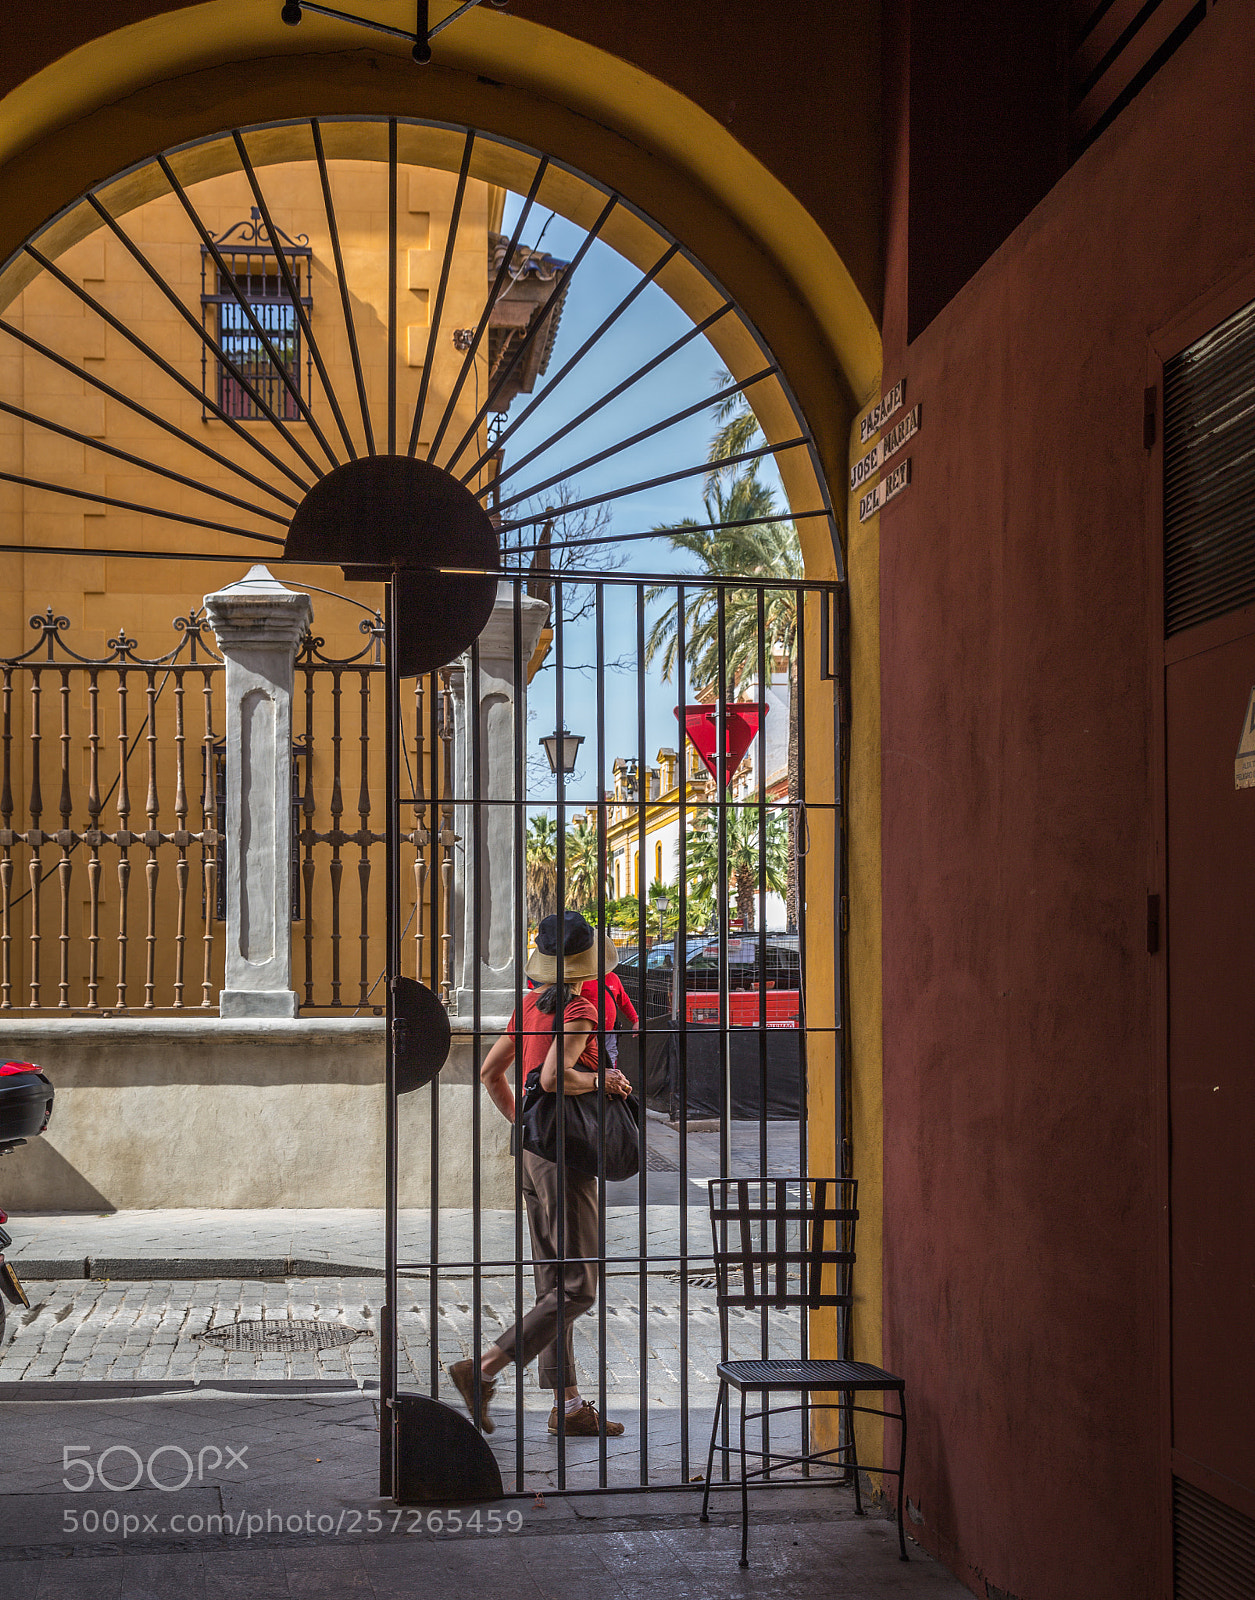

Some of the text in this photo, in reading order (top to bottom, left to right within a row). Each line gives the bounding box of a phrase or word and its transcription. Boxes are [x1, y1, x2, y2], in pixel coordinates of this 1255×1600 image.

[860, 384, 901, 441] PASAJE
[851, 407, 918, 488] JOSE MARIA
[860, 461, 907, 520] DEL REY
